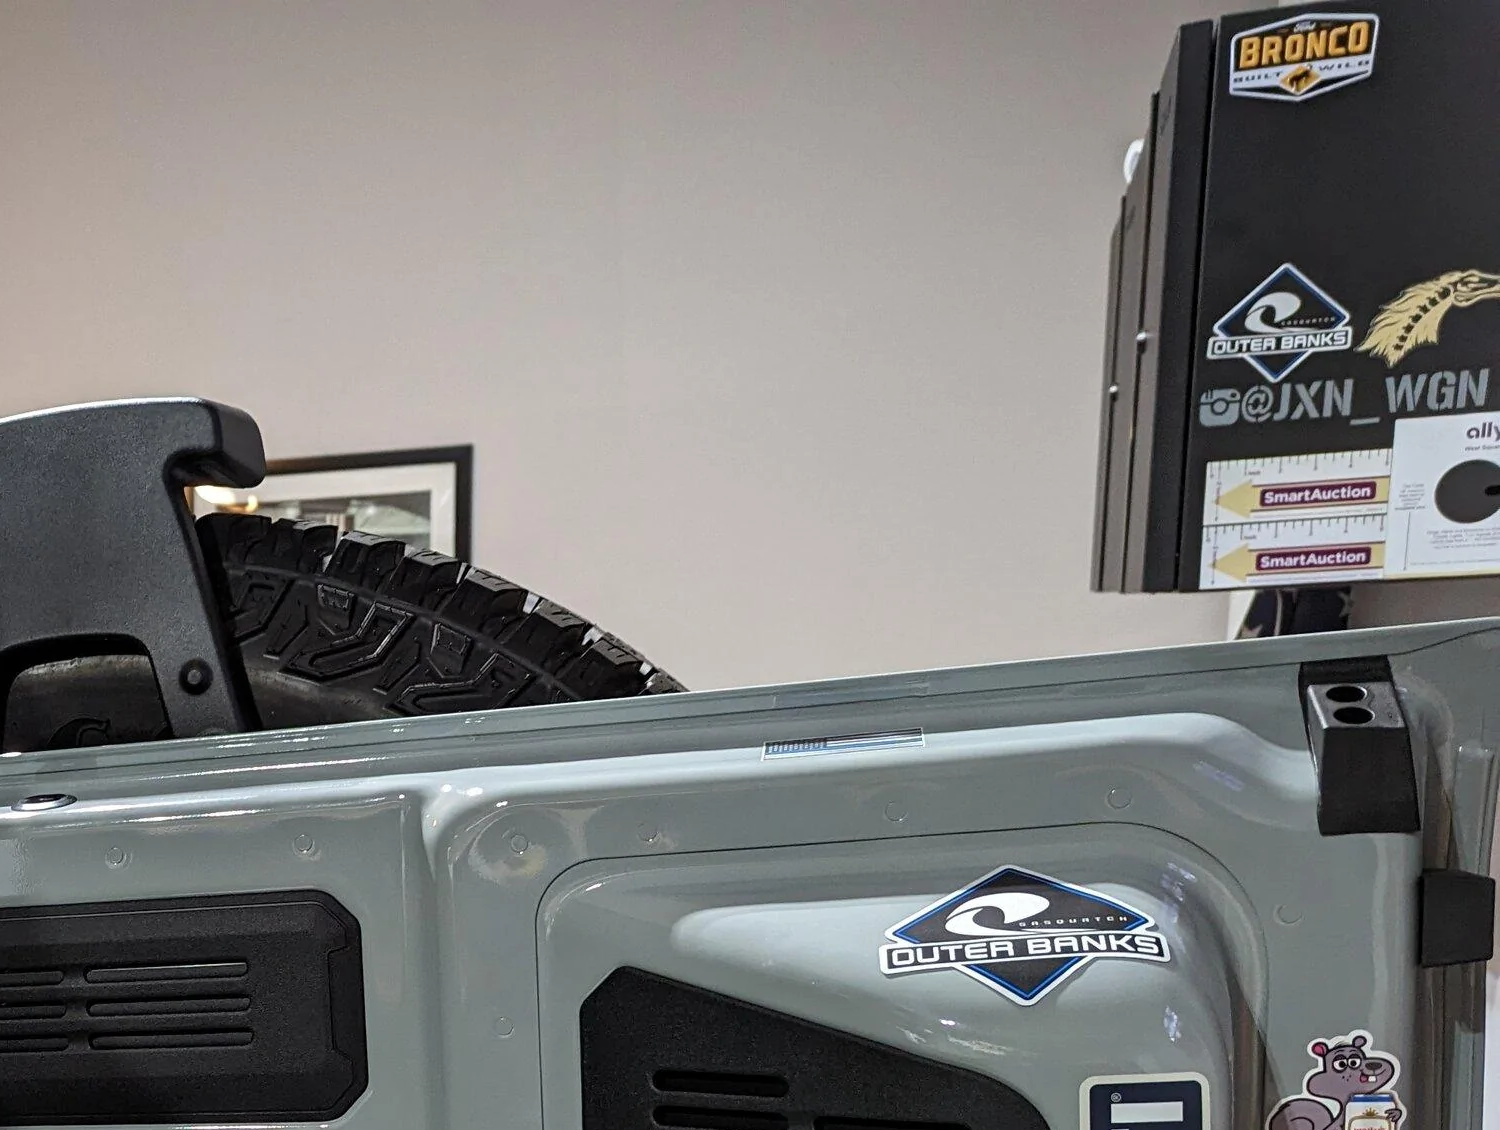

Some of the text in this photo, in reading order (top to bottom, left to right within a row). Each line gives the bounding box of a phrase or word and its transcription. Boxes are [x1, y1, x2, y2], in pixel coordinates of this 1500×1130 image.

[1239, 21, 1370, 69] BRONCO
[1213, 331, 1346, 354] OUTER BANKS
[1263, 485, 1371, 504] SmartAuction
[1260, 550, 1367, 569] SmartAuction
[1019, 916, 1129, 927] SASQUATCH
[891, 934, 1160, 967] OUTER BANKS
